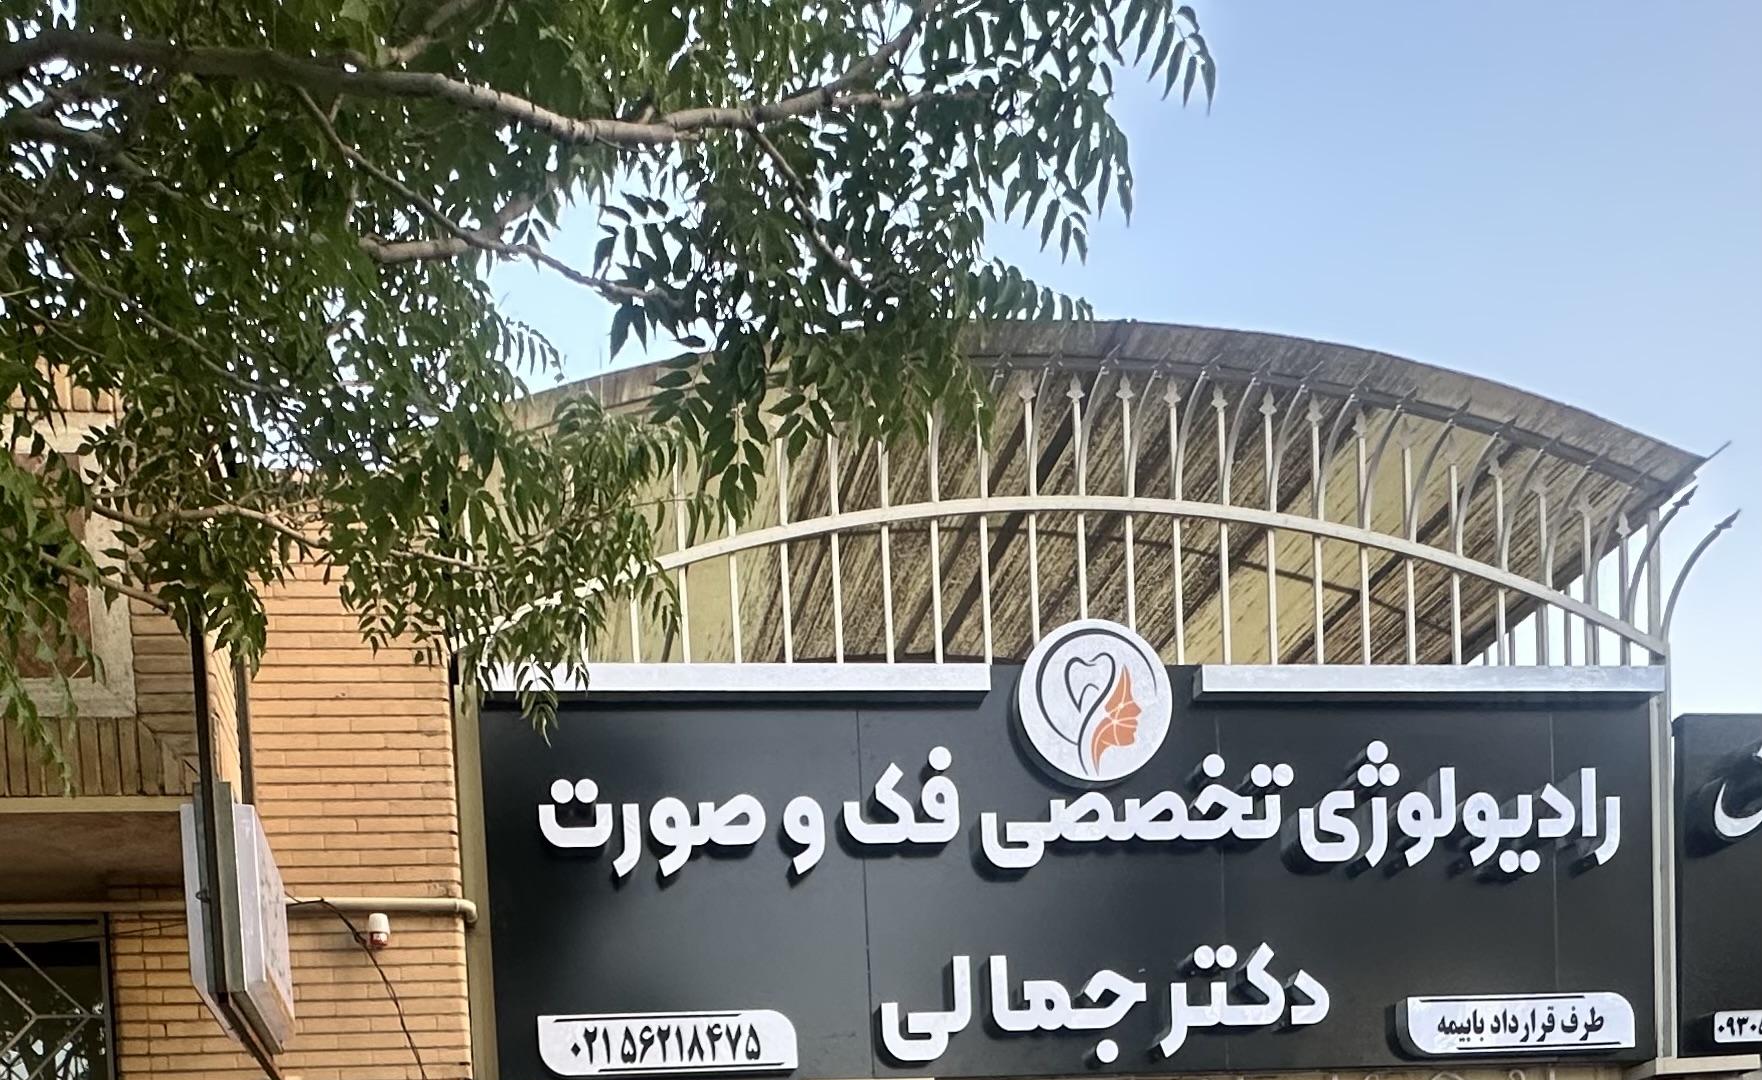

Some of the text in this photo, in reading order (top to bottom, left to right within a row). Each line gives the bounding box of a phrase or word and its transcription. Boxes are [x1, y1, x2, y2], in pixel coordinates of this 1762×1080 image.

[538, 778, 767, 878] صورت
[783, 795, 826, 875] و
[843, 745, 961, 844] فک
[980, 753, 1294, 868] تخصصی
[1298, 740, 1621, 873] رادیولوژی
[881, 942, 1330, 1063] دکتر جمالی
[1560, 1006, 1605, 1042] طرف
